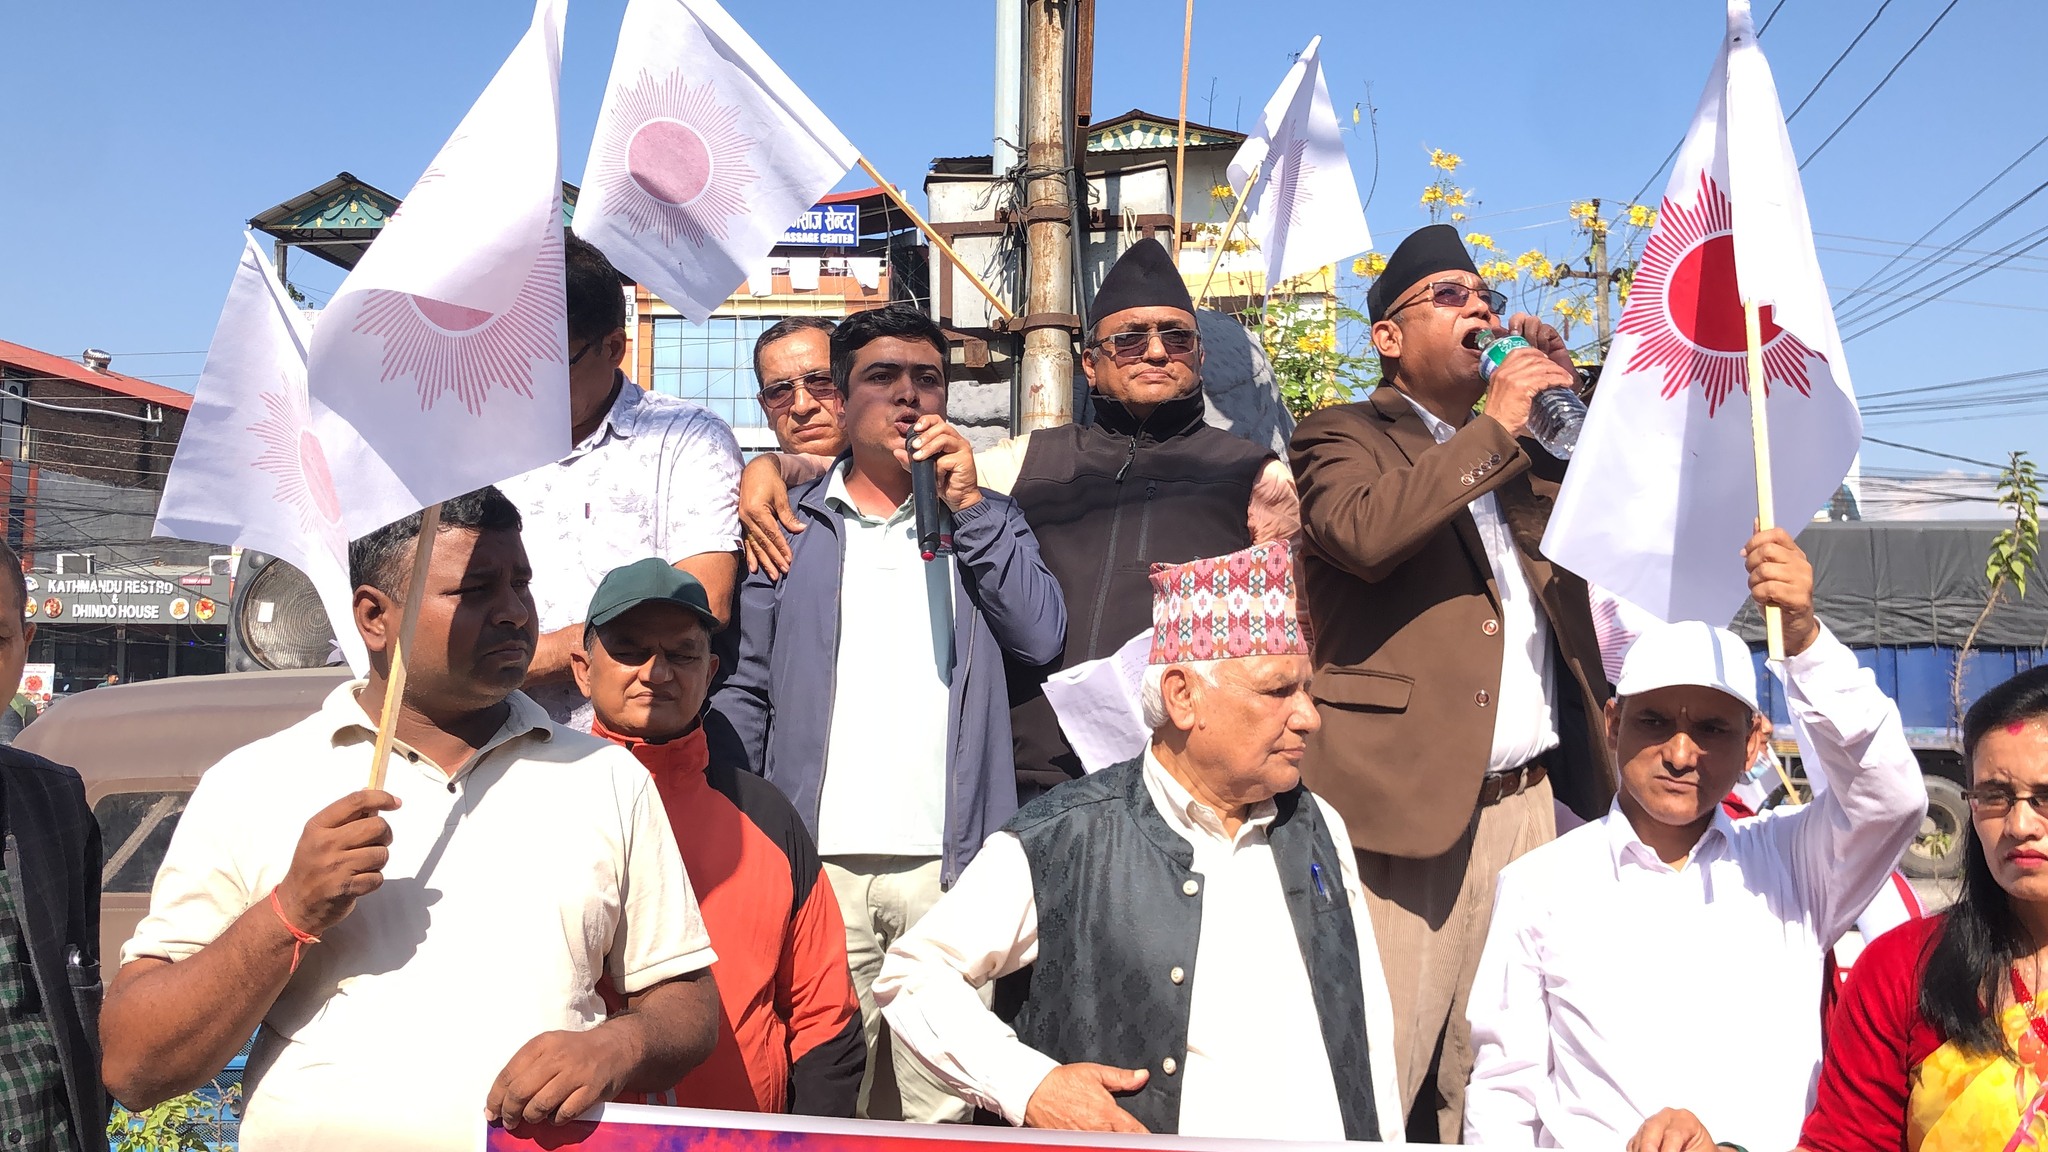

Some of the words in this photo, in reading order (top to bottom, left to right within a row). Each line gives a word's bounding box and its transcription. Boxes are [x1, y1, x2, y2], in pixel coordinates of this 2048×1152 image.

[820, 232, 854, 244] CENTER
[48, 579, 123, 593] KATHMANDU
[124, 580, 174, 595] RESTRO
[112, 593, 119, 604] &
[72, 604, 117, 618] DHINDO
[118, 605, 160, 619] HOUSE
